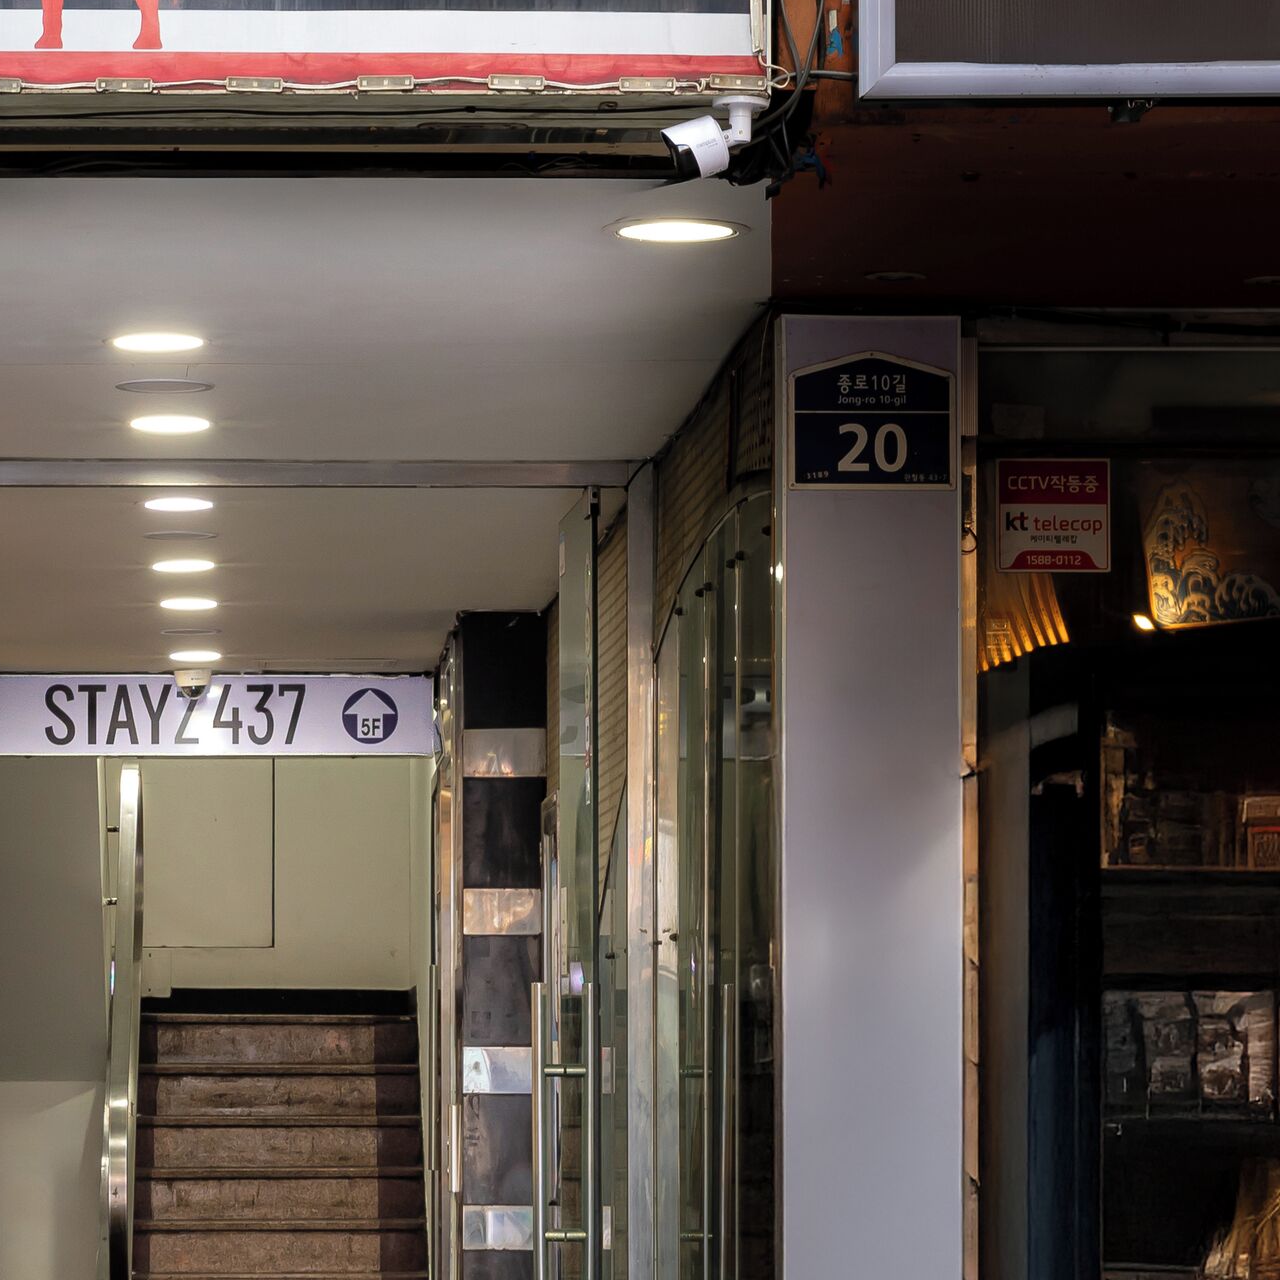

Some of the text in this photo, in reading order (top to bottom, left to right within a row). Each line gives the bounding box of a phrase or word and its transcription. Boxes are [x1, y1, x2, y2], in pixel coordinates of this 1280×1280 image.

[837, 374, 907, 393] 종로10길
[837, 395, 907, 406] Jong-ro 10-gil
[837, 423, 908, 472] 20
[1007, 474, 1099, 494] CCTV작동중
[1005, 511, 1103, 535] kt telecop
[1026, 555, 1081, 565] 1588-0112
[211, 683, 307, 746] 437
[360, 717, 381, 737] 5F
